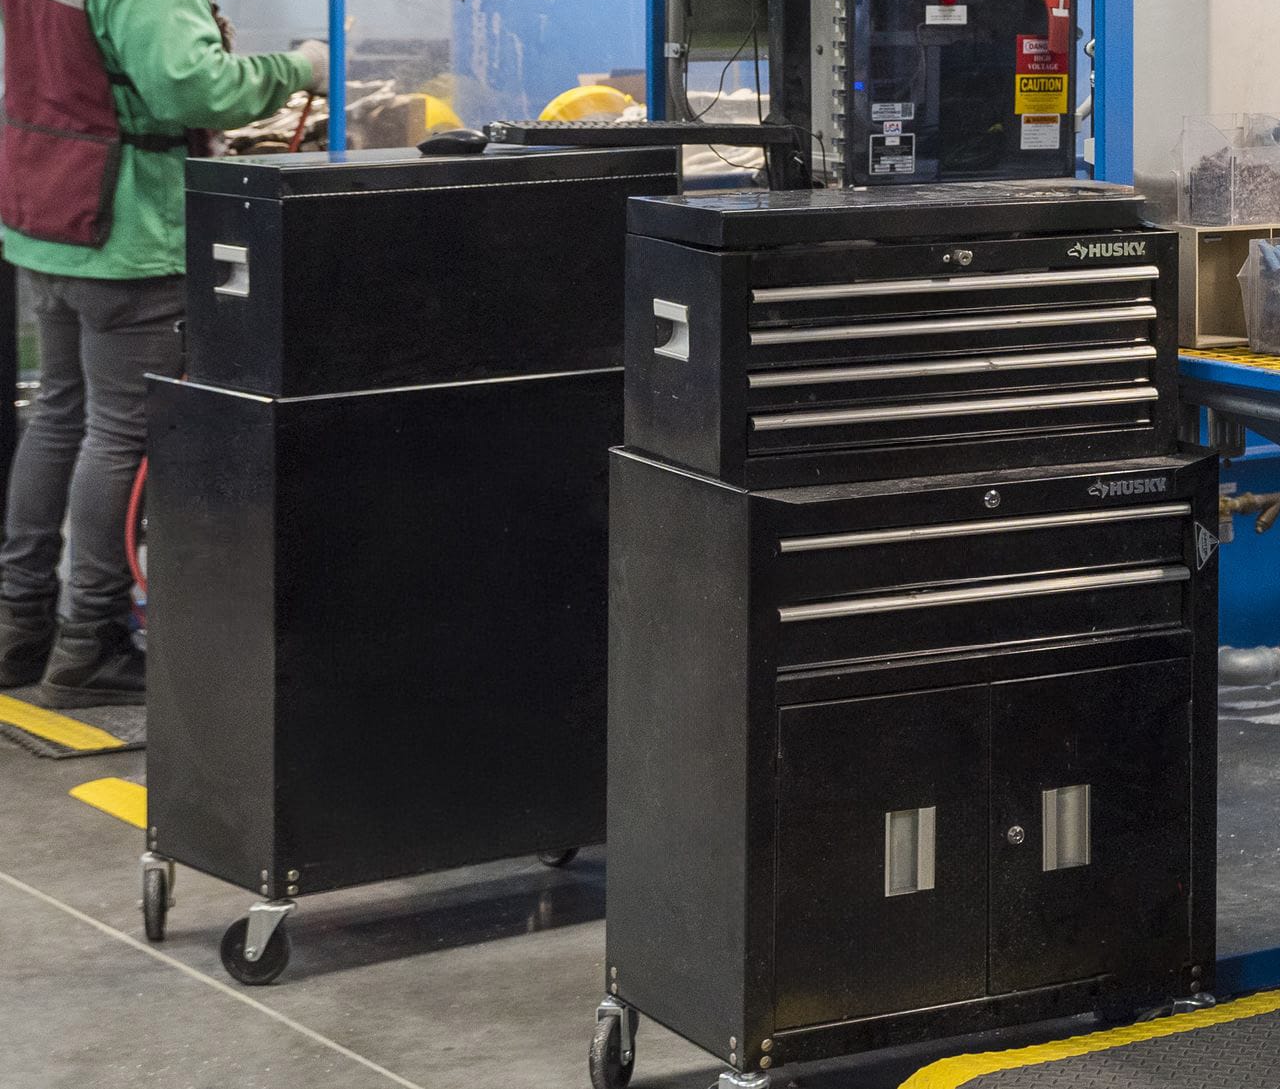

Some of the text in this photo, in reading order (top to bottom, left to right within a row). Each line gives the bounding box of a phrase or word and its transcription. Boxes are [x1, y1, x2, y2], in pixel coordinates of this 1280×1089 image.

[1027, 63, 1058, 71] VOLTAGE
[1021, 78, 1062, 91] CAUTION
[1089, 242, 1145, 258] HUSKY
[1109, 477, 1167, 496] HUSKY
